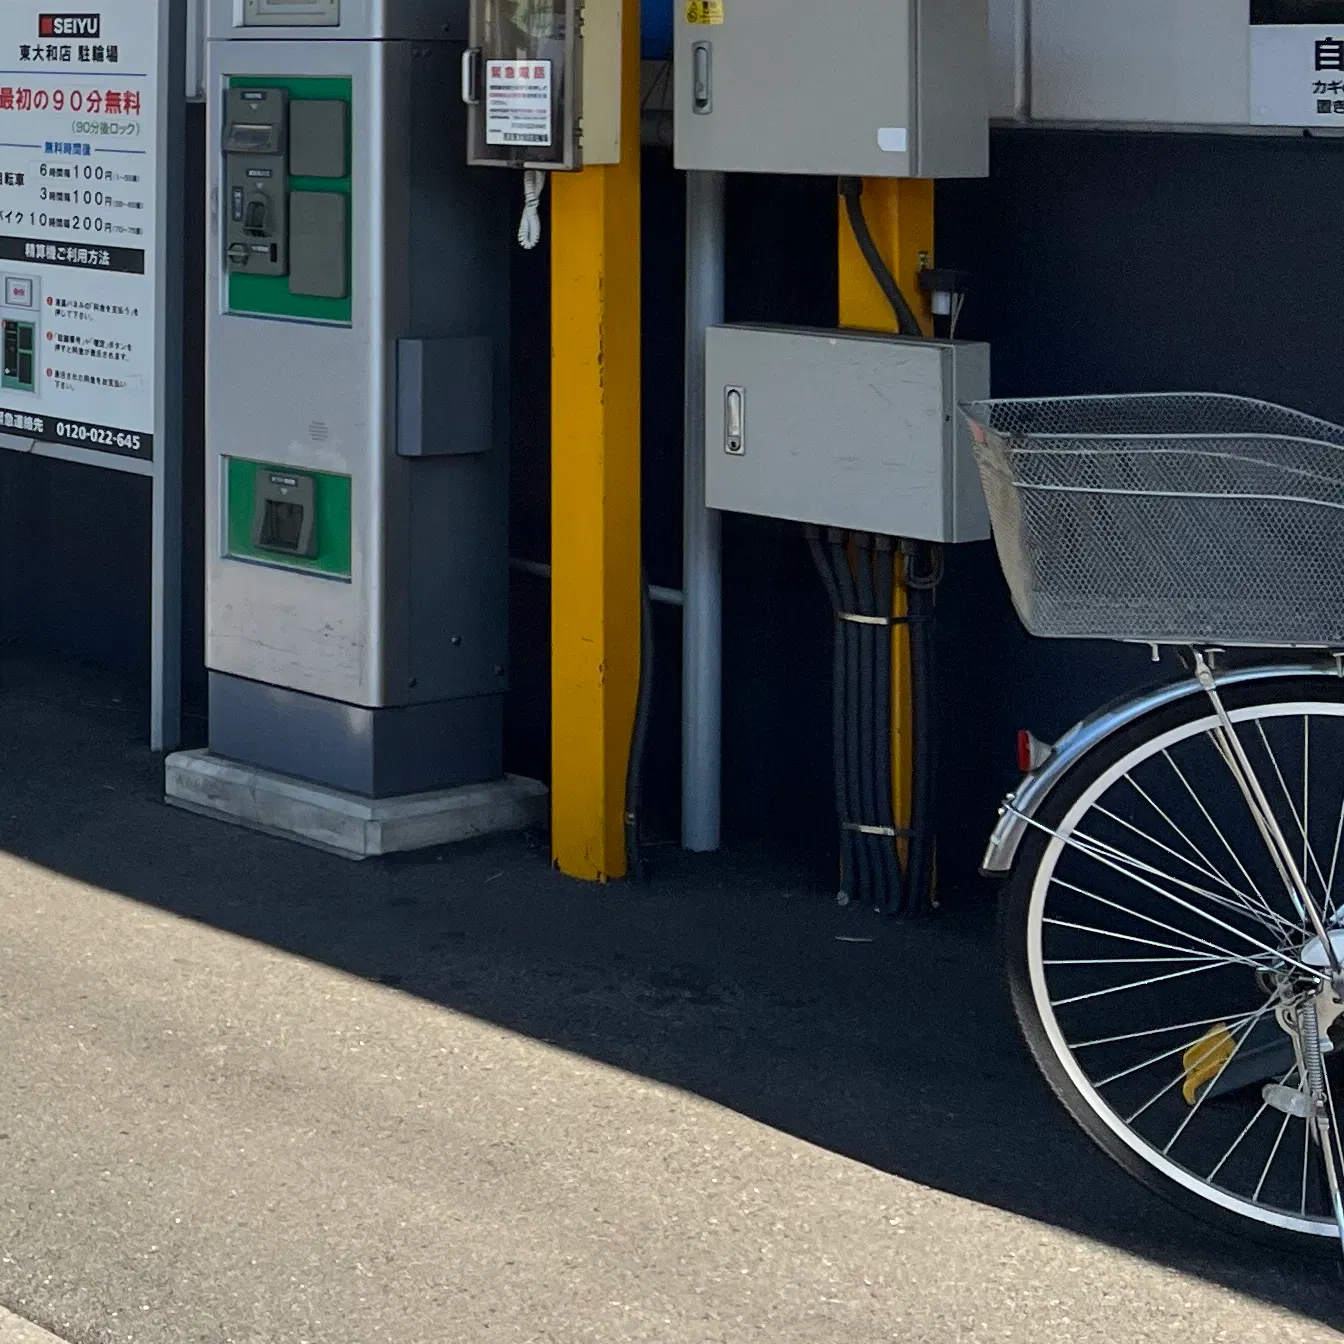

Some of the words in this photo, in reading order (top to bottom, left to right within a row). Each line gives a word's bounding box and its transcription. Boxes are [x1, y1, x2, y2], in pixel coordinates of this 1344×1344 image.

[53, 17, 98, 35] SEIYU
[18, 44, 71, 62] 東大和店
[78, 45, 119, 63] 駐輪場
[1312, 80, 1344, 95] カギ
[71, 120, 141, 137] (90分後ロック)
[44, 141, 92, 156] 無料時間後
[25, 242, 110, 267] 精算機ご利用方法
[56, 421, 141, 450] 0120-022-645
